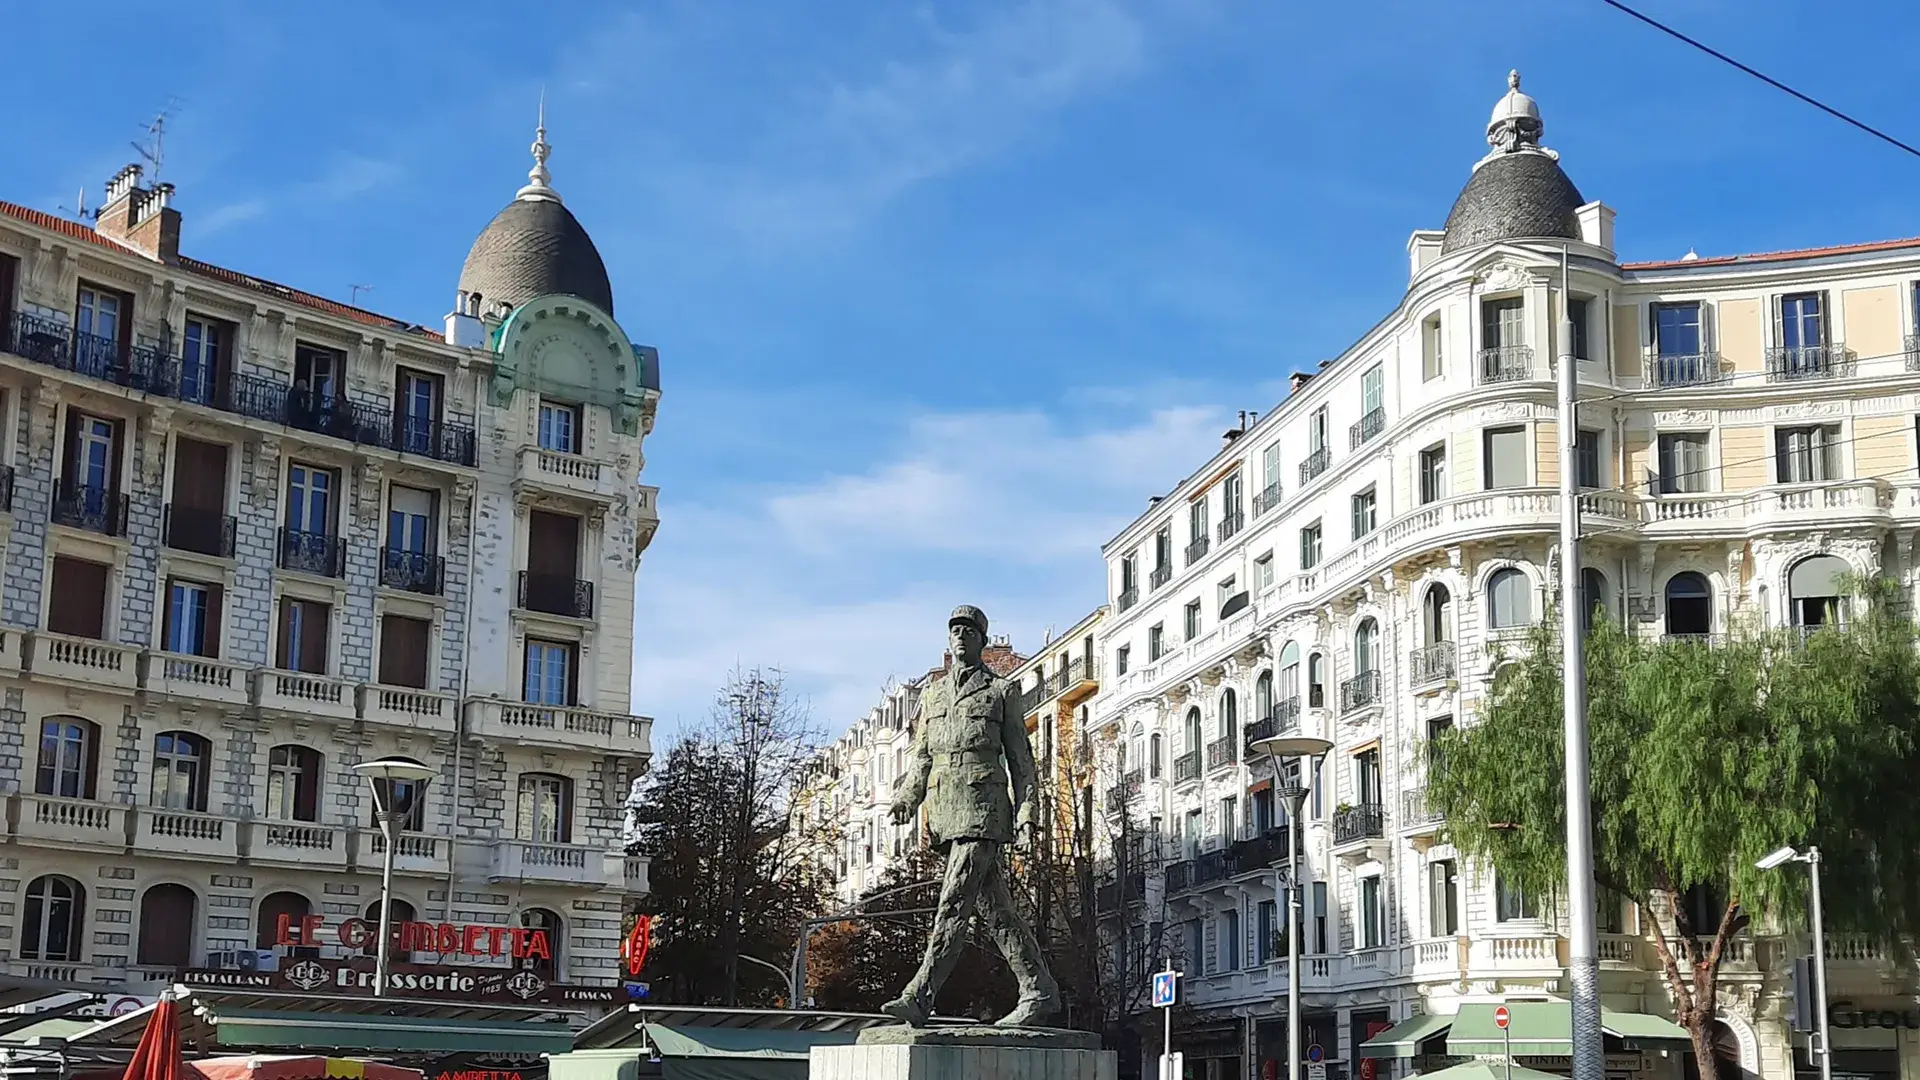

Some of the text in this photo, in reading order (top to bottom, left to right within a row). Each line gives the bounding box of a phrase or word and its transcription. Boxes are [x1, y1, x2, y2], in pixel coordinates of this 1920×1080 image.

[276, 912, 325, 946] LE
[633, 927, 644, 963] TABAC
[184, 972, 271, 986] RESTAURANT
[295, 966, 320, 980] BG
[564, 990, 613, 1000] POISSONS
